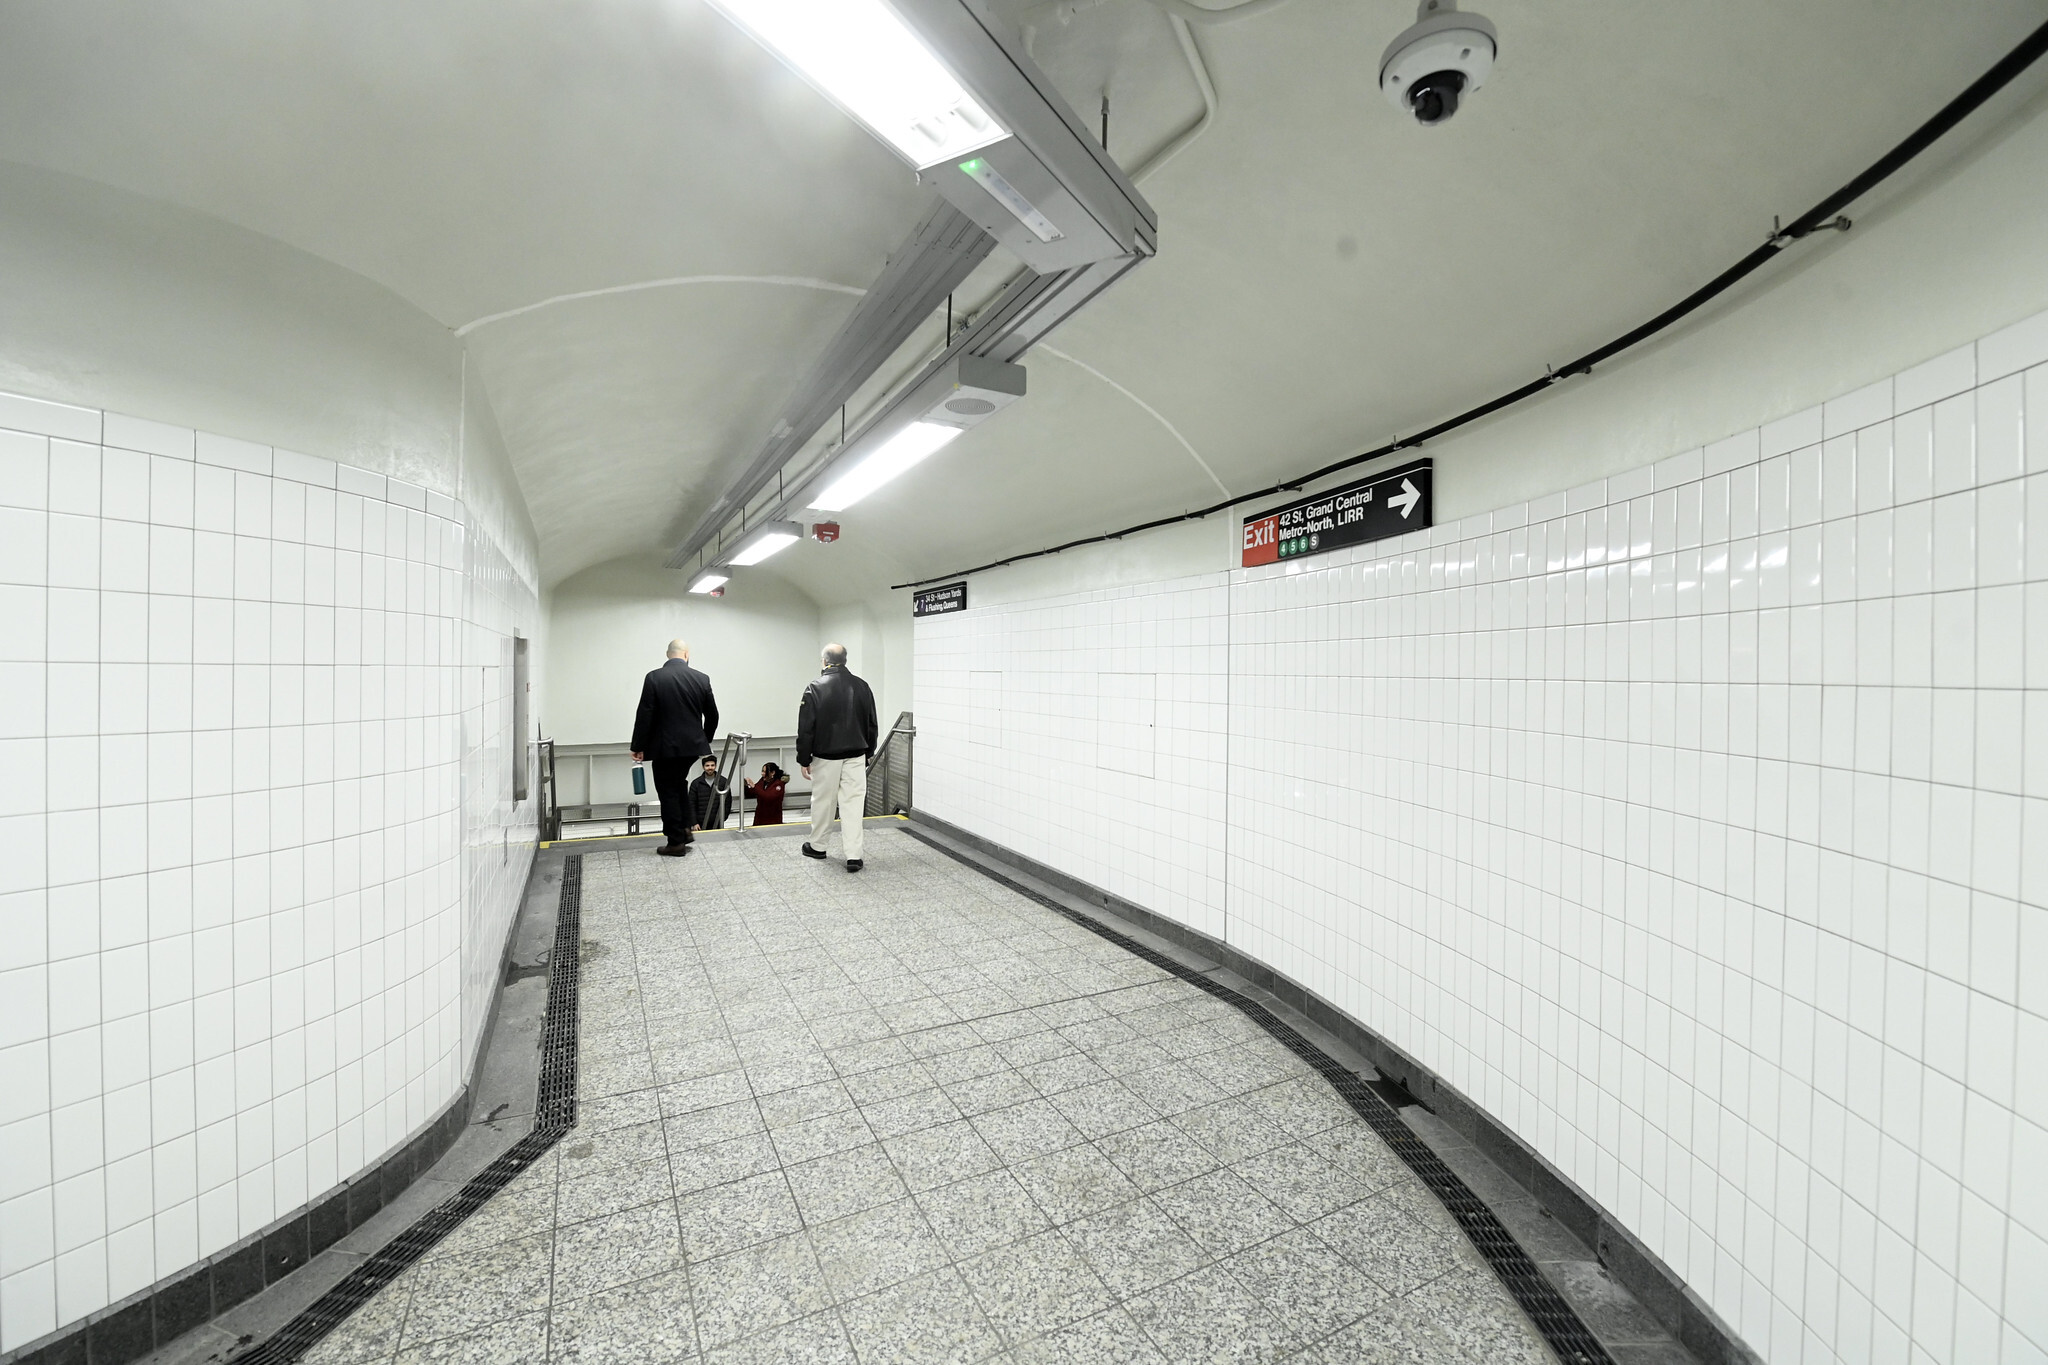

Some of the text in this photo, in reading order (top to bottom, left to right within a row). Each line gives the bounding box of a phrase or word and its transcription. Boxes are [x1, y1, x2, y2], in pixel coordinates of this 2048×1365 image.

[1279, 487, 1373, 527] 42 St, Grand Central
[1279, 506, 1364, 541] Metro-North, LIRR
[1243, 520, 1275, 550] Exit
